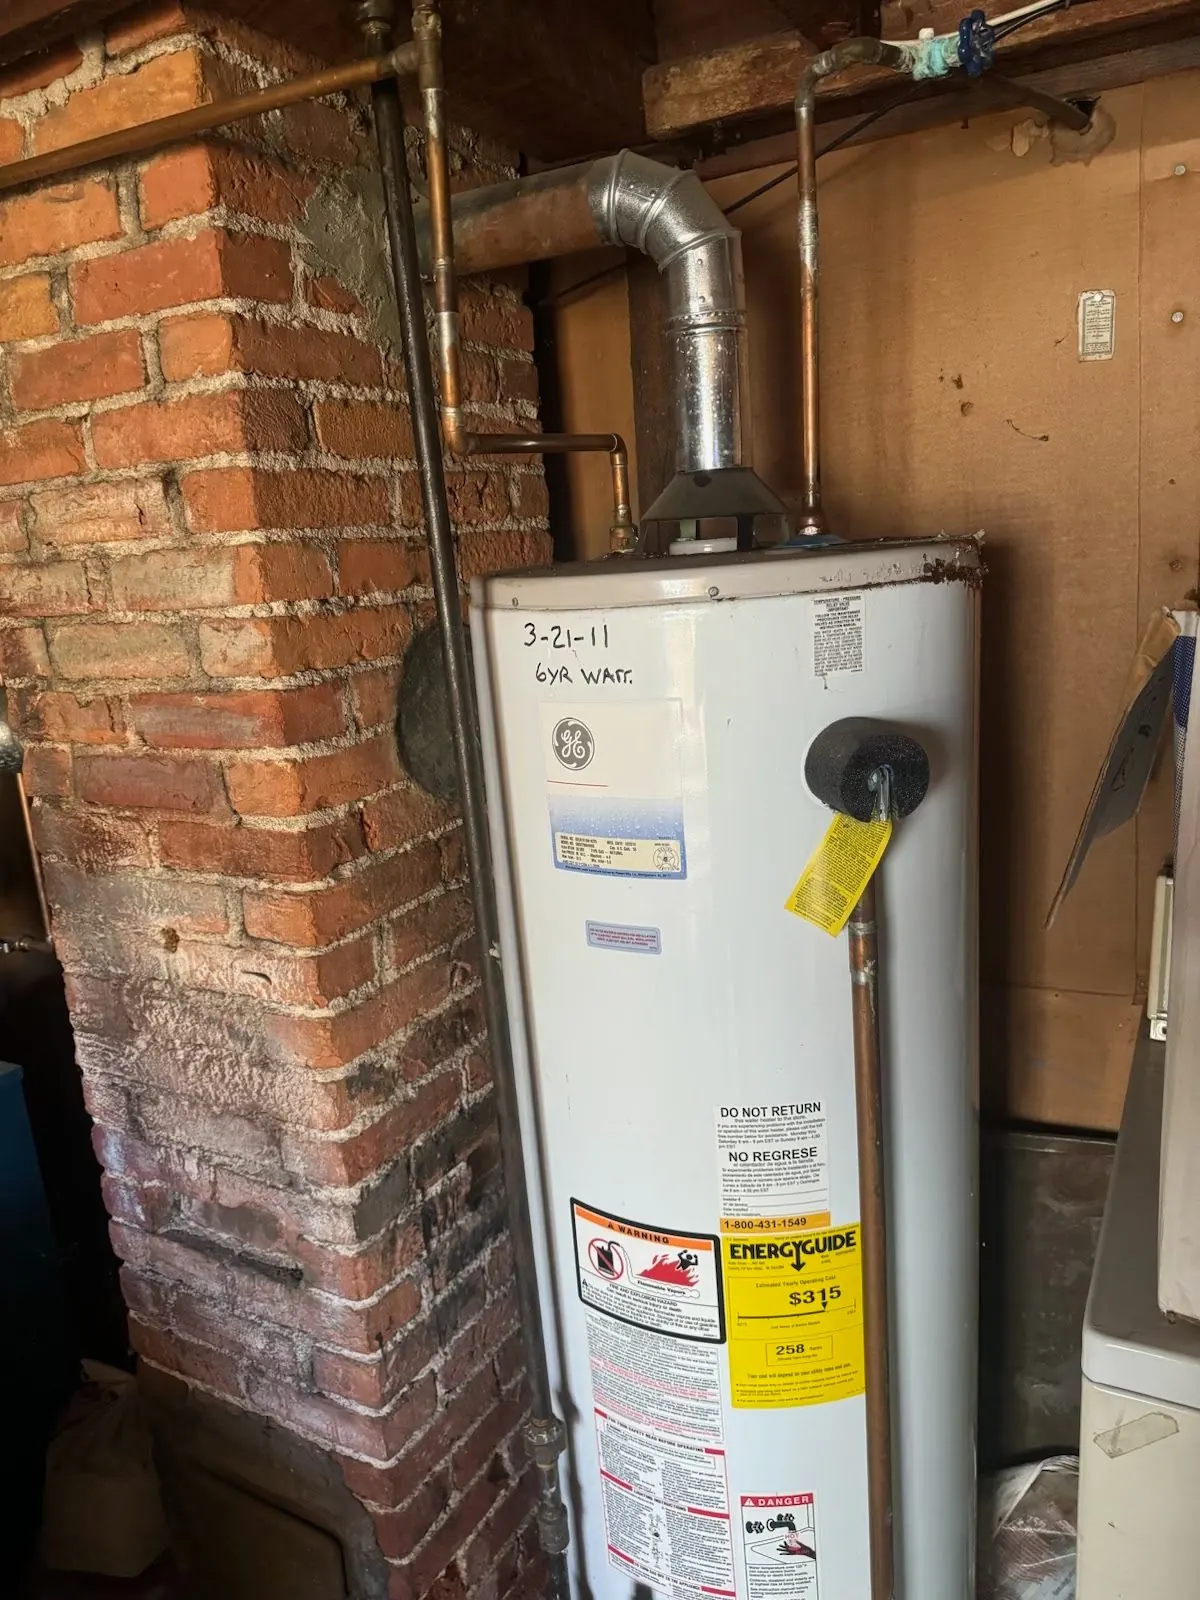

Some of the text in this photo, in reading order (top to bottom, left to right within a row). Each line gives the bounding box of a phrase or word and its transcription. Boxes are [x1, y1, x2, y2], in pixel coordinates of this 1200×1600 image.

[524, 622, 608, 649] 3-21-11
[720, 1102, 821, 1118] DO NOT RETURN
[729, 1146, 818, 1162] NO REGRESE
[725, 1217, 807, 1230] 1-800-431-1549
[618, 1223, 669, 1245] WARNING
[730, 1230, 857, 1264] ENERGYGUIDE
[800, 1276, 824, 1286] Operating
[789, 1285, 842, 1307] $315
[776, 1343, 805, 1356] 258
[758, 1495, 809, 1506] DANGER
[785, 1532, 800, 1540] HOT
